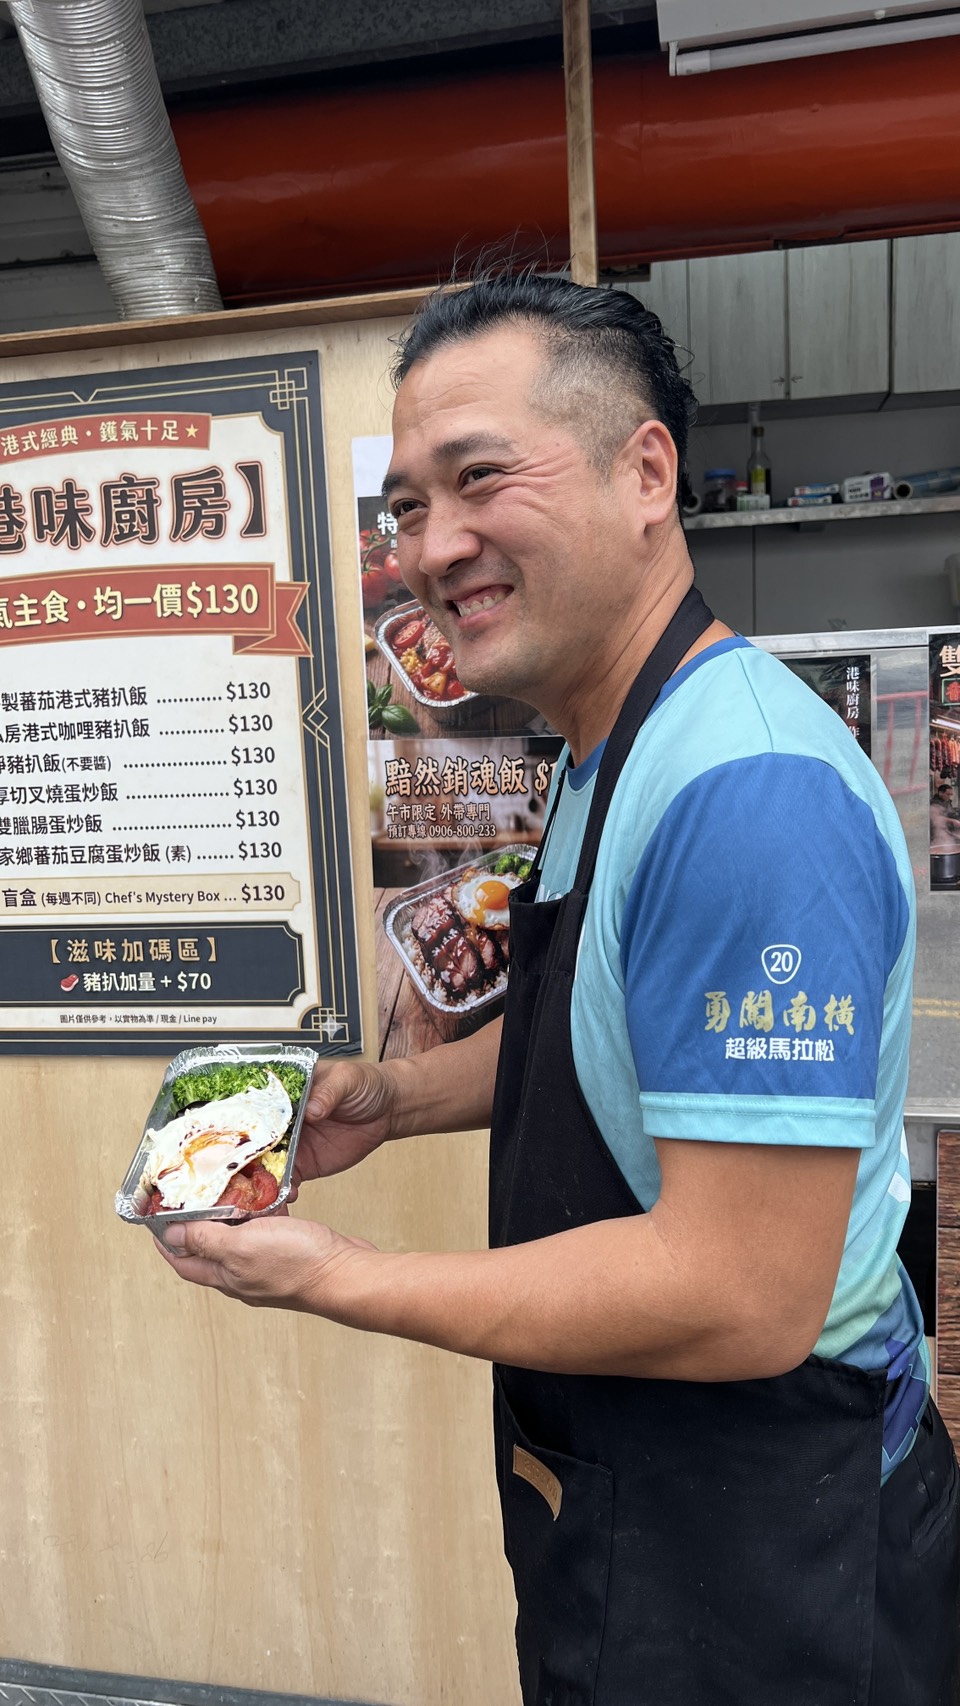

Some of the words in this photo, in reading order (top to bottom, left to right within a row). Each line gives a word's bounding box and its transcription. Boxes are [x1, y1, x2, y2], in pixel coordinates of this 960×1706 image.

[226, 681, 271, 701] $130
[0, 718, 150, 744] 房港式咖哩豬扒飯
[228, 715, 273, 733] $130
[231, 746, 275, 765] $130
[385, 755, 528, 797] 黯然銷魂飯
[233, 778, 278, 797] $130
[235, 810, 280, 829] $130
[386, 802, 437, 822] 午市限定
[440, 802, 491, 822] 外帶專門
[387, 824, 427, 839] 預訂專線
[429, 823, 497, 838] 0906-800-233
[165, 845, 191, 864] (素)
[238, 841, 282, 860] $130
[2, 888, 37, 907] 盲盒
[41, 891, 101, 907] (每週不同)
[105, 890, 143, 904] Chef's
[146, 890, 194, 906] Mystery
[197, 890, 221, 903] Box
[241, 884, 285, 903] $130
[770, 951, 794, 973] 20
[82, 971, 156, 992] 豬扒加量
[177, 970, 212, 992] $70
[160, 1014, 177, 1024] 現金
[183, 1014, 201, 1023] Line
[202, 1016, 218, 1025] pay
[725, 1037, 835, 1062] 超級馬拉松
